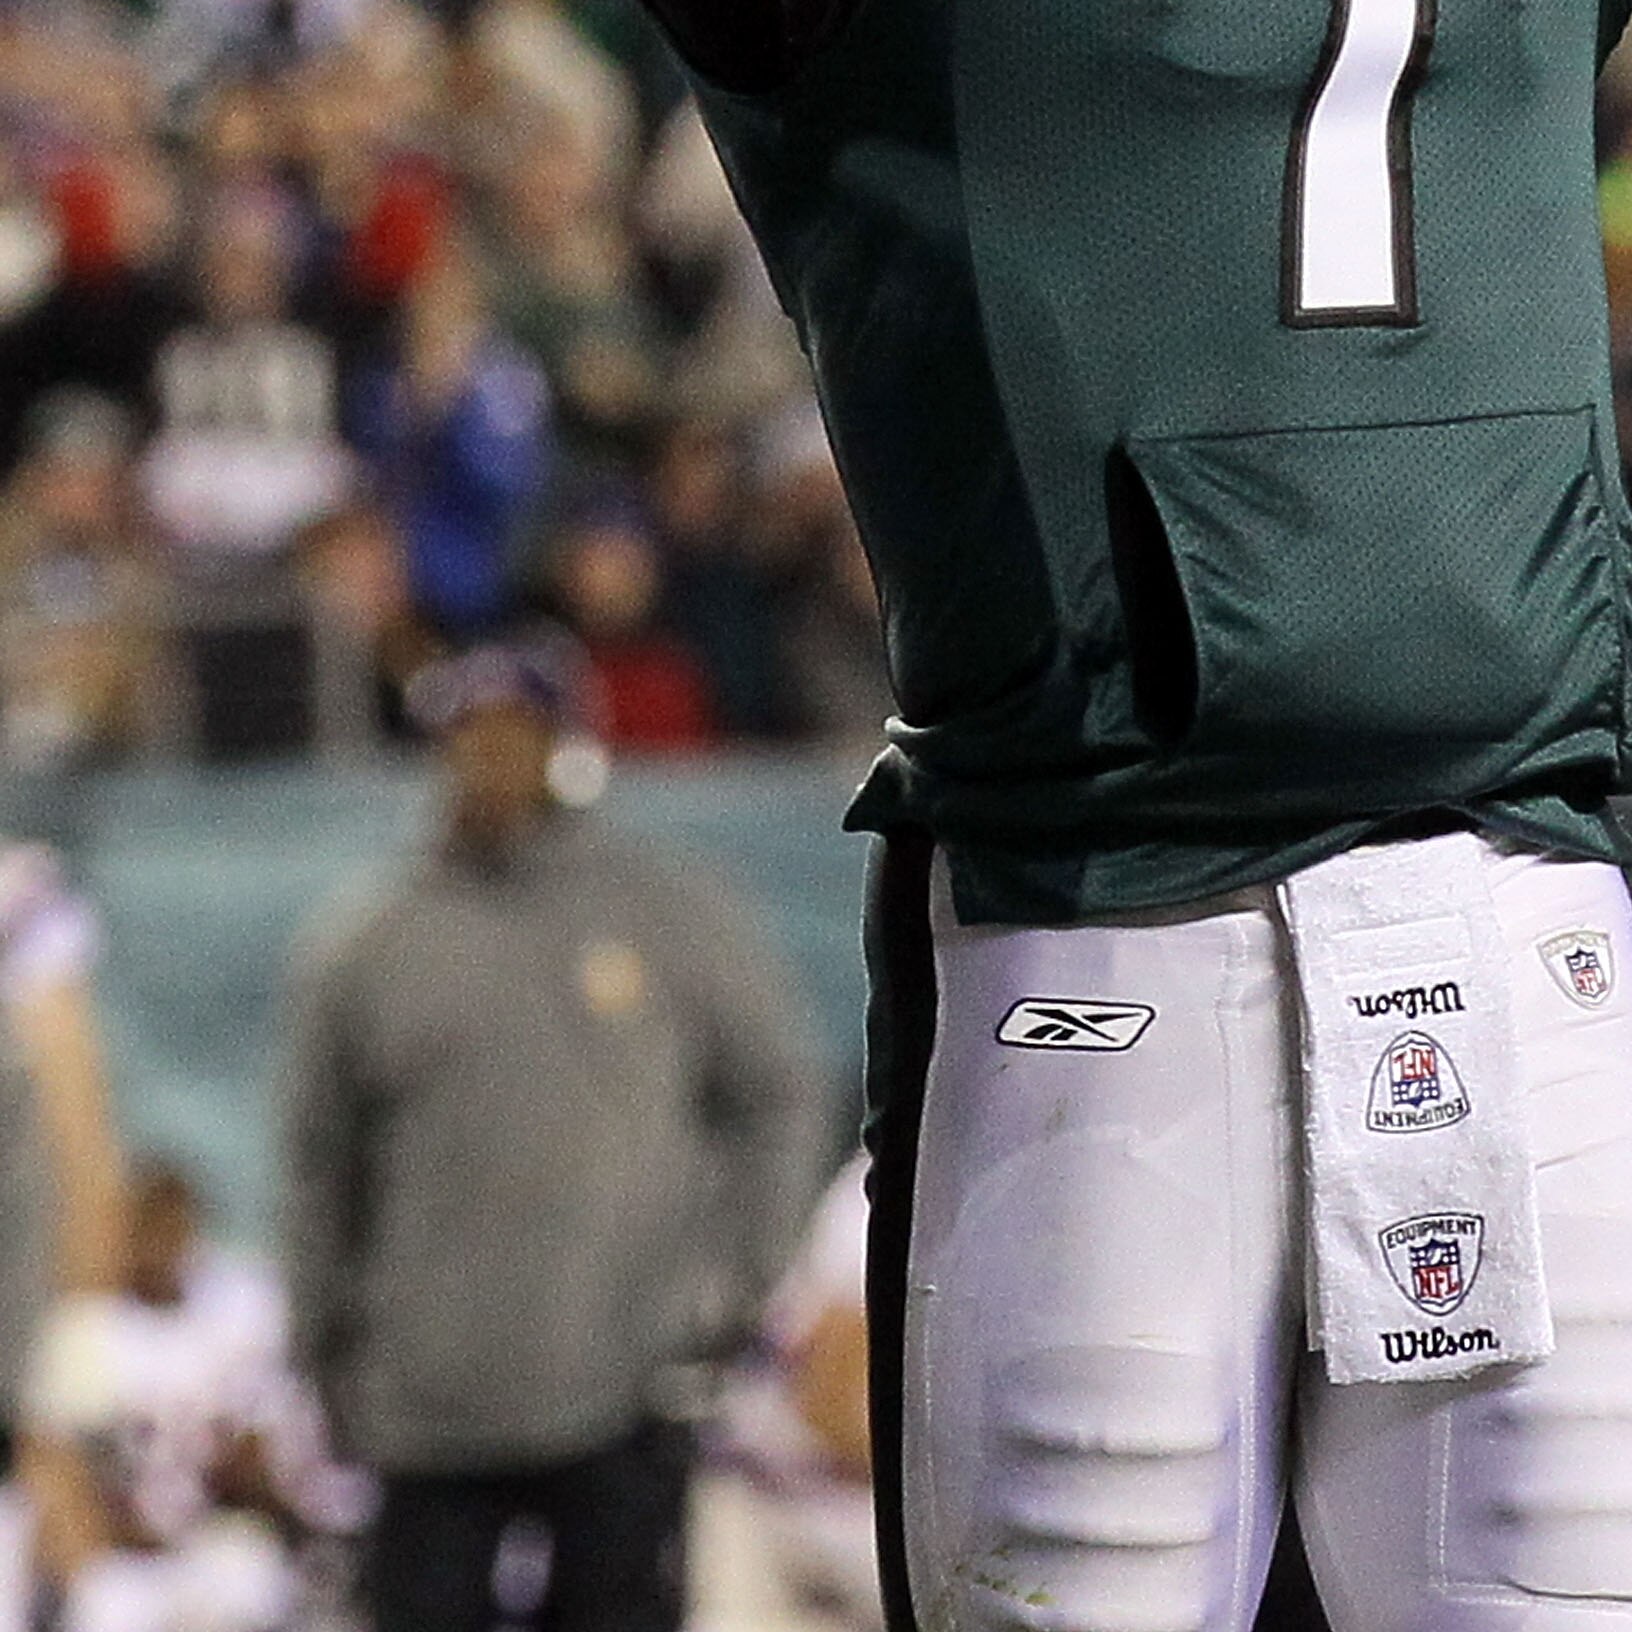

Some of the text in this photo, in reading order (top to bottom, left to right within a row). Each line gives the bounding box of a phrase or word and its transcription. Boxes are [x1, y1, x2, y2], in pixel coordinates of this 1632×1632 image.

[1351, 981, 1466, 1018] Wilson
[1393, 1047, 1437, 1080] NFL
[1374, 1098, 1464, 1128] EQUIPMENT
[1386, 1218, 1477, 1249] EQUIPMENT
[1413, 1265, 1463, 1298] NFL
[1379, 1326, 1499, 1363] Wilson
